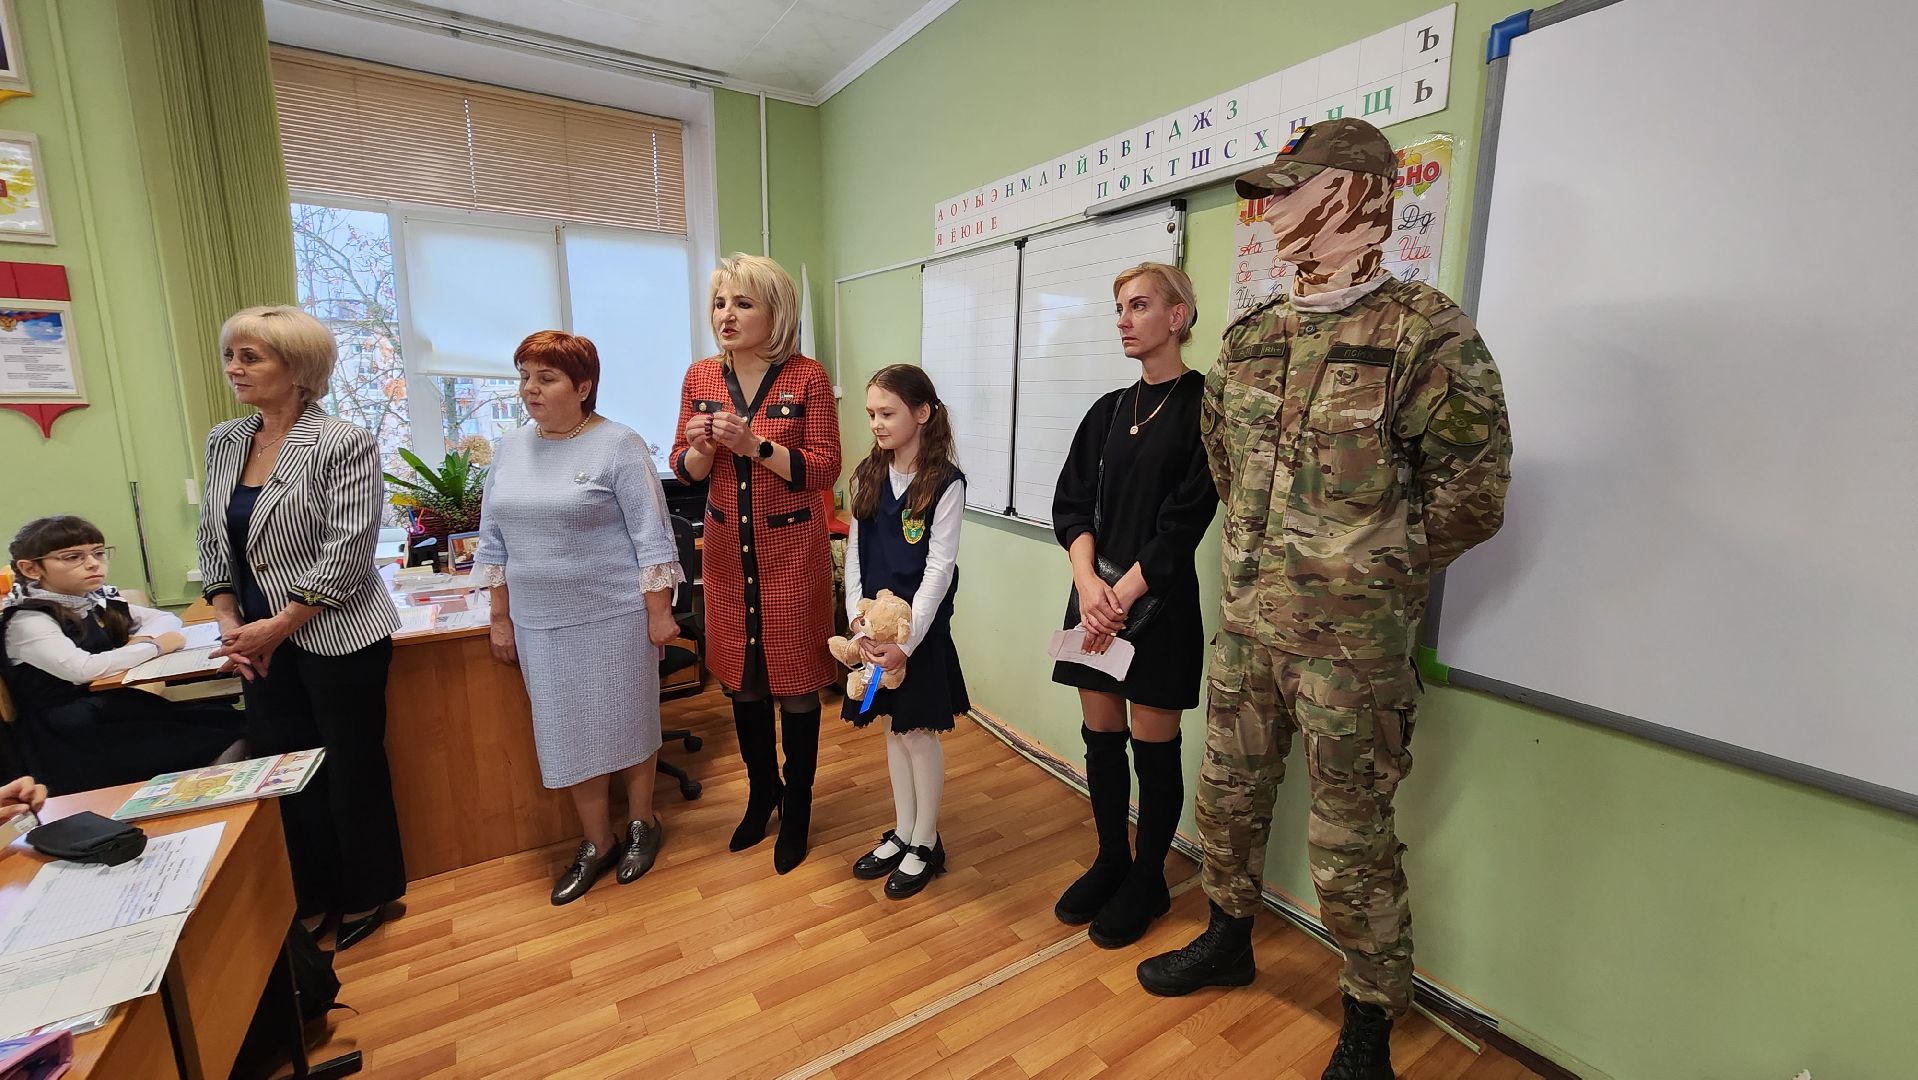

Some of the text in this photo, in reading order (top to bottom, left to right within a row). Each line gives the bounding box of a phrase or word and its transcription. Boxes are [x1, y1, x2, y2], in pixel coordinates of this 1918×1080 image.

[936, 234, 942, 246] Я
[951, 228, 956, 243] Ё
[961, 225, 970, 239] Ю
[976, 221, 983, 234] И
[991, 216, 997, 230] Е
[1097, 181, 1108, 199] П
[1119, 174, 1131, 191] Ф
[1142, 166, 1154, 185] К
[1168, 158, 1180, 176] Т
[1191, 146, 1212, 170] Ш
[1224, 138, 1238, 159] С
[1254, 129, 1268, 151] Х
[1362, 86, 1394, 117] Щ
[1413, 79, 1433, 104] Ь
[938, 209, 944, 221] А
[950, 204, 958, 216] О
[962, 198, 969, 212] У
[975, 193, 984, 208] Ы
[991, 189, 998, 202] Э
[1006, 183, 1014, 198] Н
[1021, 176, 1032, 192] М
[1059, 164, 1066, 179] Р
[1076, 154, 1088, 176] Й
[1099, 148, 1108, 165] Б
[1121, 140, 1131, 157] В
[1145, 130, 1155, 149] Г
[1169, 120, 1181, 142] Д
[1192, 108, 1212, 132] Ж
[1226, 100, 1237, 120] З
[1417, 26, 1439, 53] Ъ
